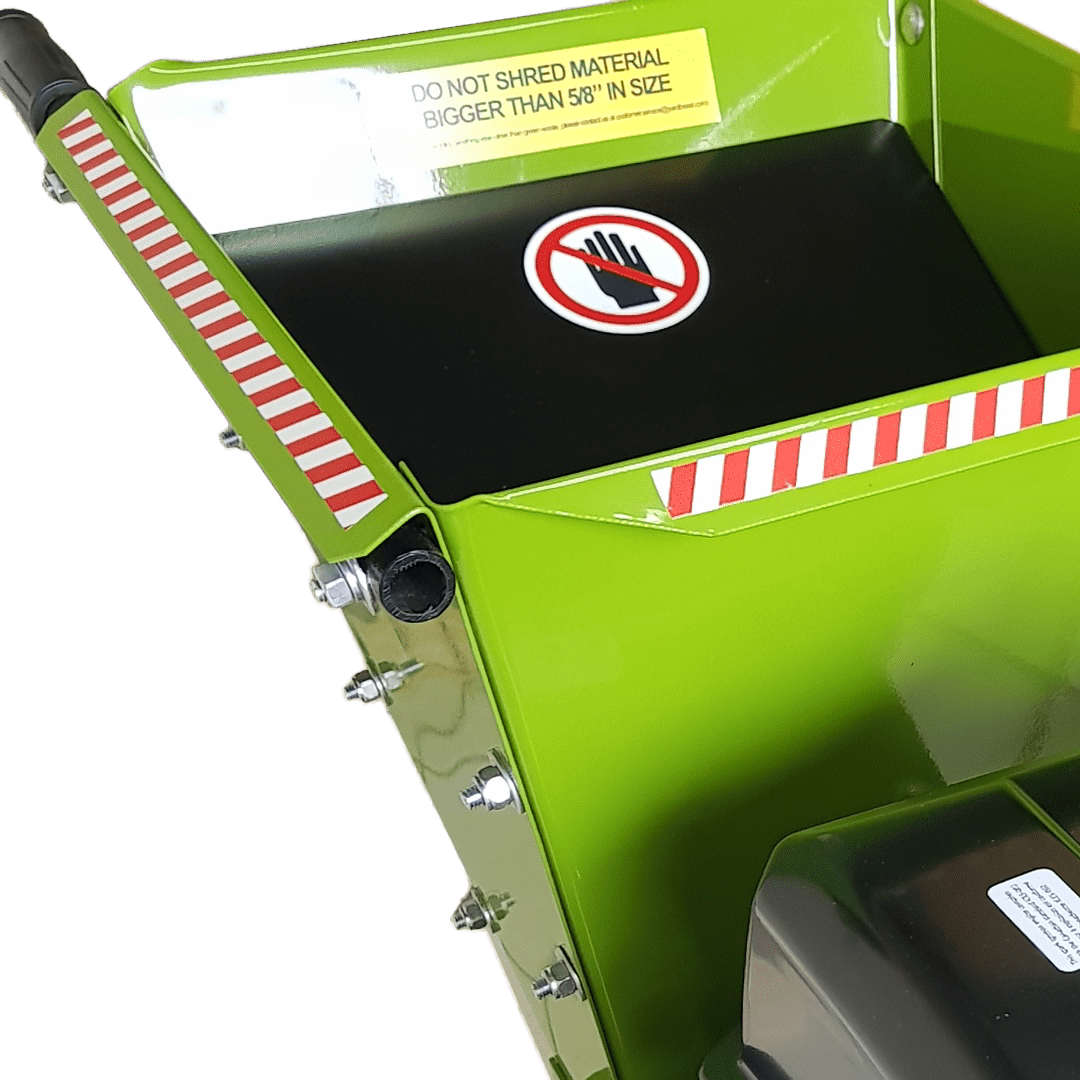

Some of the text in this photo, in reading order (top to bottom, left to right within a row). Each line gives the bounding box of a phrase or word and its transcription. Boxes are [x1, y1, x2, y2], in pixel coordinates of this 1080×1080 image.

[411, 47, 671, 103] DO NOT SHRED MATERIAL
[423, 100, 506, 129] BIGGER
[506, 89, 564, 116] THAN
[606, 81, 627, 101] IN
[630, 73, 673, 97] SIZE
